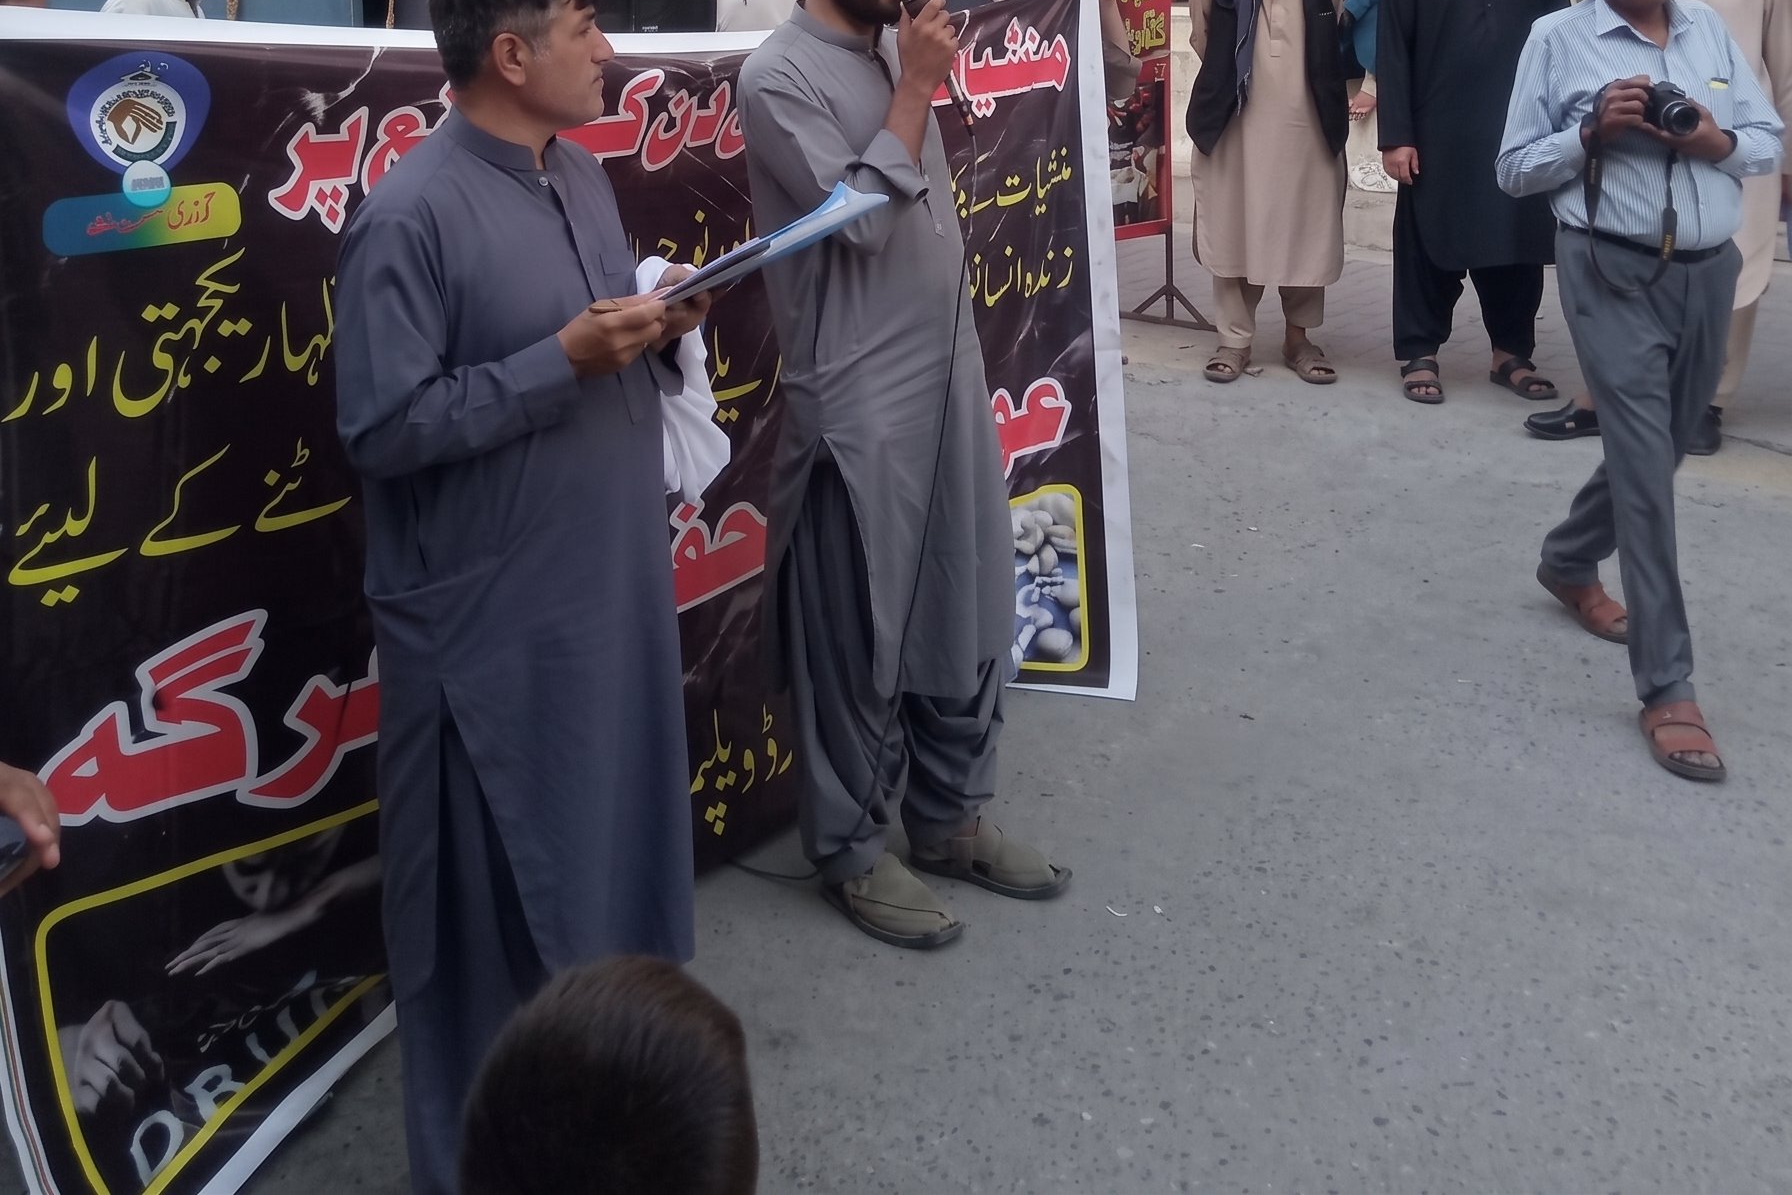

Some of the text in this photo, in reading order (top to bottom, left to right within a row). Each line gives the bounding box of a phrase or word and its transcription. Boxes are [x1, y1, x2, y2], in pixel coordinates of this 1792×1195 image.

[931, 17, 1071, 118] منشیا
[268, 106, 369, 235] پر
[1, 336, 97, 423] اور
[140, 444, 241, 557] کے
